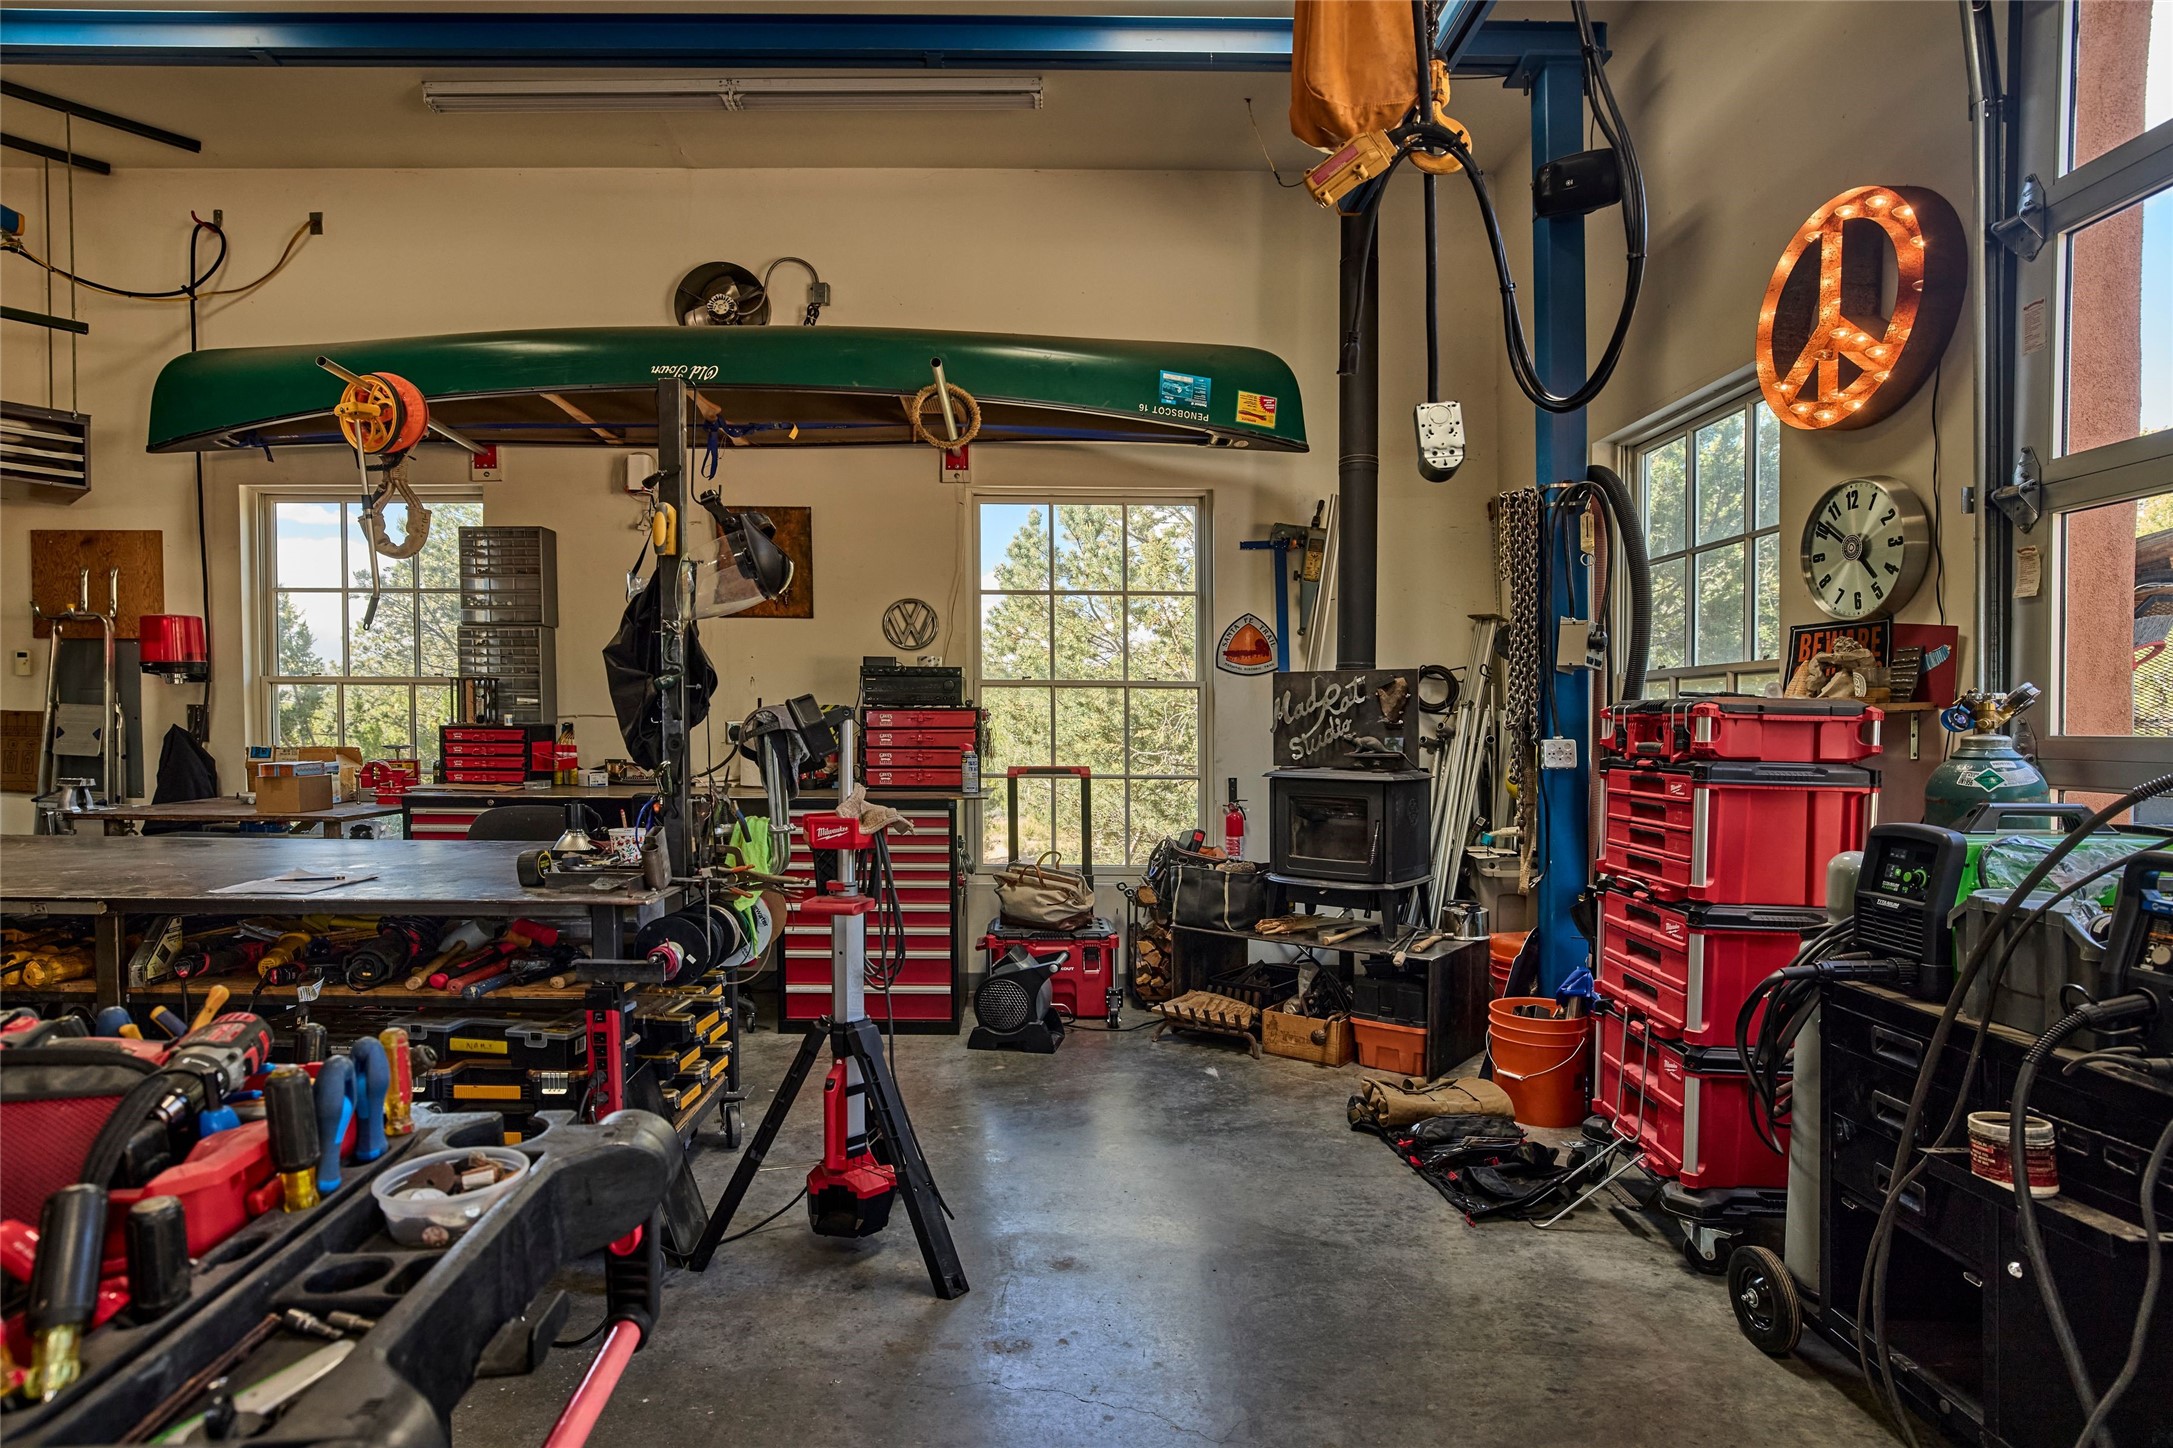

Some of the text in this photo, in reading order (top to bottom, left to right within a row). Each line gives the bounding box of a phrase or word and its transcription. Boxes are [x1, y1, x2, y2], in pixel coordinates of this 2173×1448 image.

[650, 364, 719, 381] Old Town
[1138, 403, 1209, 421] PENOBSCOT 16
[1845, 489, 1859, 511] 12
[1868, 492, 1878, 511] 1
[1827, 501, 1842, 521] 11
[1880, 508, 1896, 526] 2
[1887, 535, 1904, 548] 3
[1812, 552, 1826, 563] 9
[1884, 562, 1900, 575] 4
[1819, 574, 1832, 589] 8
[1870, 581, 1884, 600] 5
[1834, 587, 1845, 604] 7
[1853, 591, 1862, 610] 6
[1222, 624, 1240, 647] SANTA
[1259, 624, 1276, 648] TRAIL
[1798, 626, 1882, 663] BEWRE
[1269, 674, 1323, 733] Mad
[1288, 716, 1353, 760] Studio
[815, 825, 849, 838] Milwaukee
